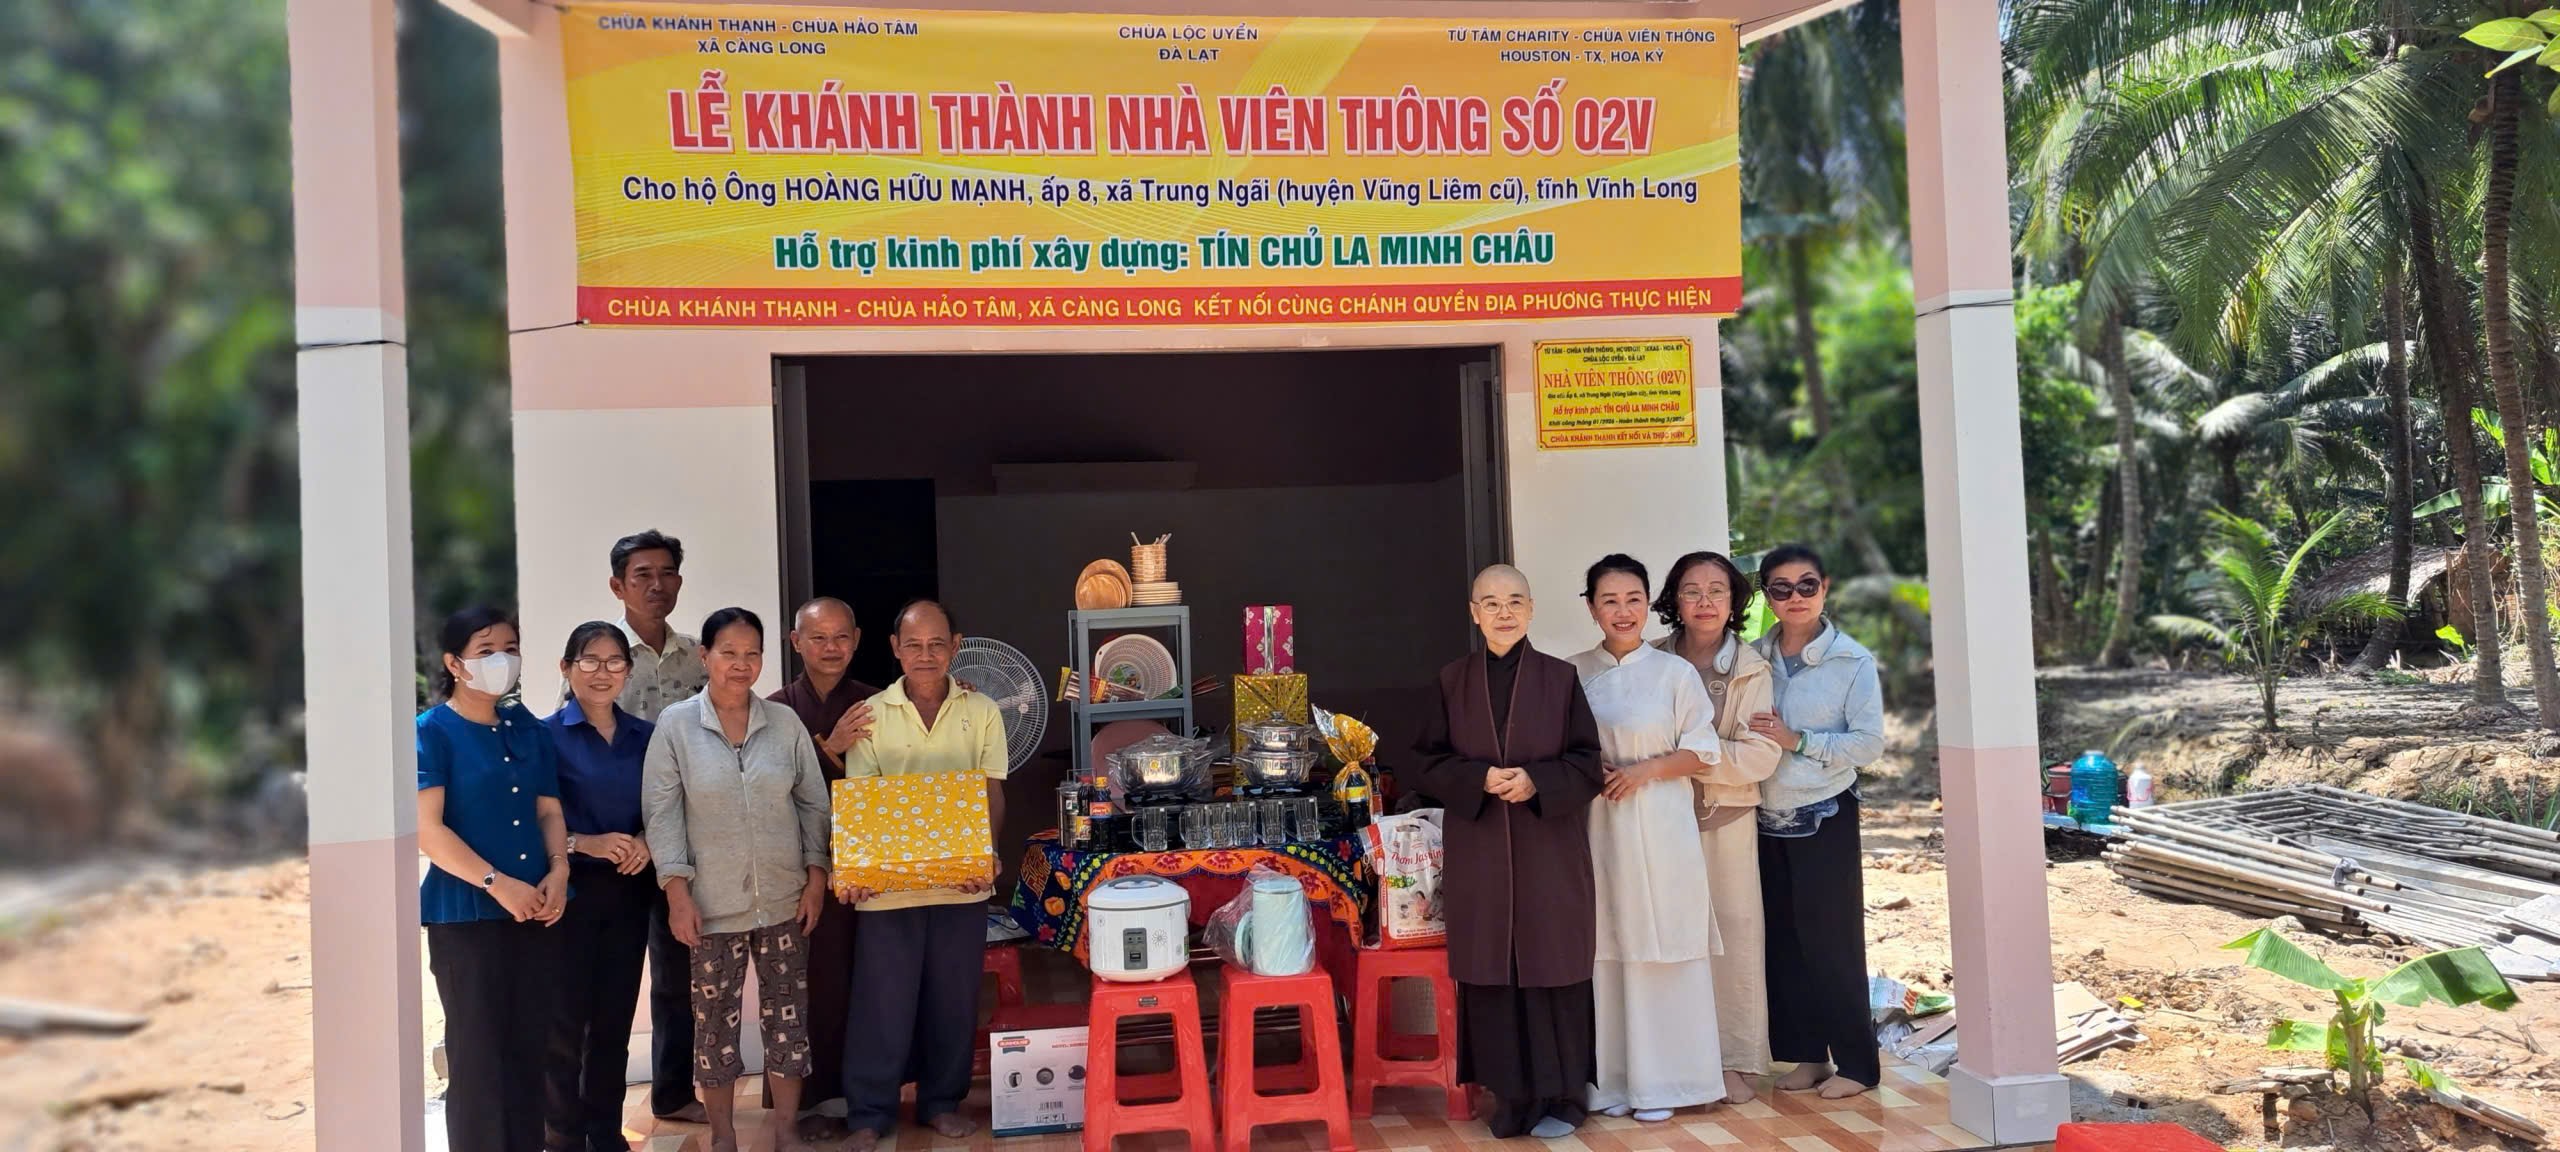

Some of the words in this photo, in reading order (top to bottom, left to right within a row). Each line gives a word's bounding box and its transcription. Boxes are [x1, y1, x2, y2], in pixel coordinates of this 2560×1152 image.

[598, 15, 647, 31] CHÙA
[652, 16, 713, 32] KHÁNH
[719, 19, 777, 35] THẠNH
[792, 18, 839, 34] CHÙA
[844, 18, 879, 35] HẢO
[884, 19, 918, 35] TÂM
[1119, 24, 1167, 39] CHÙA
[1173, 25, 1206, 41] LỘC
[1213, 23, 1258, 40] UYỂN
[1472, 28, 1501, 42] TÂM
[1507, 30, 1569, 42] CHARITY
[1583, 28, 1624, 42] CHÙA
[1628, 29, 1660, 42] VIÊN
[1665, 29, 1715, 42] THÔNG
[697, 41, 720, 54] XÃ
[726, 37, 774, 54] CÀNG
[780, 42, 827, 55] LONG
[1160, 46, 1182, 60] ĐÀ
[1188, 48, 1219, 63] LẠT
[1500, 51, 1571, 63] HOUSTON
[1584, 52, 1606, 64] TX,
[1611, 52, 1640, 62] HOA
[669, 69, 734, 153] LỄ
[743, 80, 922, 154] KHÁNH
[929, 82, 1097, 155] THÀNH
[1106, 83, 1210, 156] NHÀ
[1219, 85, 1329, 156] VIÊN
[1339, 85, 1490, 156] THÔNG
[1502, 78, 1567, 155] SỐ
[1573, 96, 1656, 155] 02V
[623, 177, 676, 201] Cho
[684, 177, 717, 205] hộ
[725, 172, 776, 206] Ông
[786, 172, 879, 201] HOÀNG
[889, 173, 942, 201] HỮU
[952, 179, 1032, 206] MẠNH,
[1041, 176, 1069, 206] ấp
[1078, 179, 1098, 205] 8,
[1107, 179, 1133, 201] xã
[1141, 179, 1209, 206] Trung
[1218, 179, 1269, 206] Ngãi
[1278, 178, 1355, 203] (huyện
[1364, 178, 1420, 204] Vũng
[1429, 177, 1482, 200] Liêm
[1489, 177, 1529, 205] cũ),
[1586, 177, 1635, 198] Vĩnh
[1644, 177, 1697, 203] Long
[774, 232, 820, 269] Hỗ
[829, 238, 877, 275] trợ
[886, 237, 960, 269] kinh
[970, 236, 1022, 273] phí
[1031, 236, 1091, 273] xây
[1101, 237, 1188, 275] dựng:
[1197, 230, 1250, 268] TÍN
[1260, 227, 1324, 267] CHỦ
[1333, 235, 1370, 266] LA
[1380, 232, 1463, 266] MINH
[1472, 228, 1555, 264] CHÂU
[608, 296, 671, 317] CHÙA
[679, 296, 757, 318] KHÁNH
[763, 300, 837, 320] THẠNH
[857, 296, 916, 318] CHÙA
[923, 294, 968, 318] HẢO
[973, 296, 1022, 320] TÂM,
[1028, 297, 1056, 317] XÃ
[1062, 295, 1120, 317] CÀNG
[1127, 299, 1182, 317] LONG
[1194, 292, 1232, 316] KẾT
[1239, 292, 1271, 315] NỐI
[1277, 293, 1333, 315] CÙNG
[1340, 292, 1406, 314] CHÁNH
[1413, 289, 1479, 314] QUYỀN
[1485, 294, 1517, 315] ĐỊA
[1523, 291, 1604, 311] PHƯƠNG
[1609, 291, 1661, 311] THỰC
[1667, 289, 1712, 309] HIỆN
[1544, 368, 1571, 388] NHÀ
[1574, 368, 1605, 387] VIÊN
[1608, 366, 1654, 386] THÔNG
[1657, 369, 1686, 386] (02V)
[1632, 404, 1639, 412] LA
[1641, 403, 1658, 412] MINH
[1660, 401, 1679, 411] CHÂU
